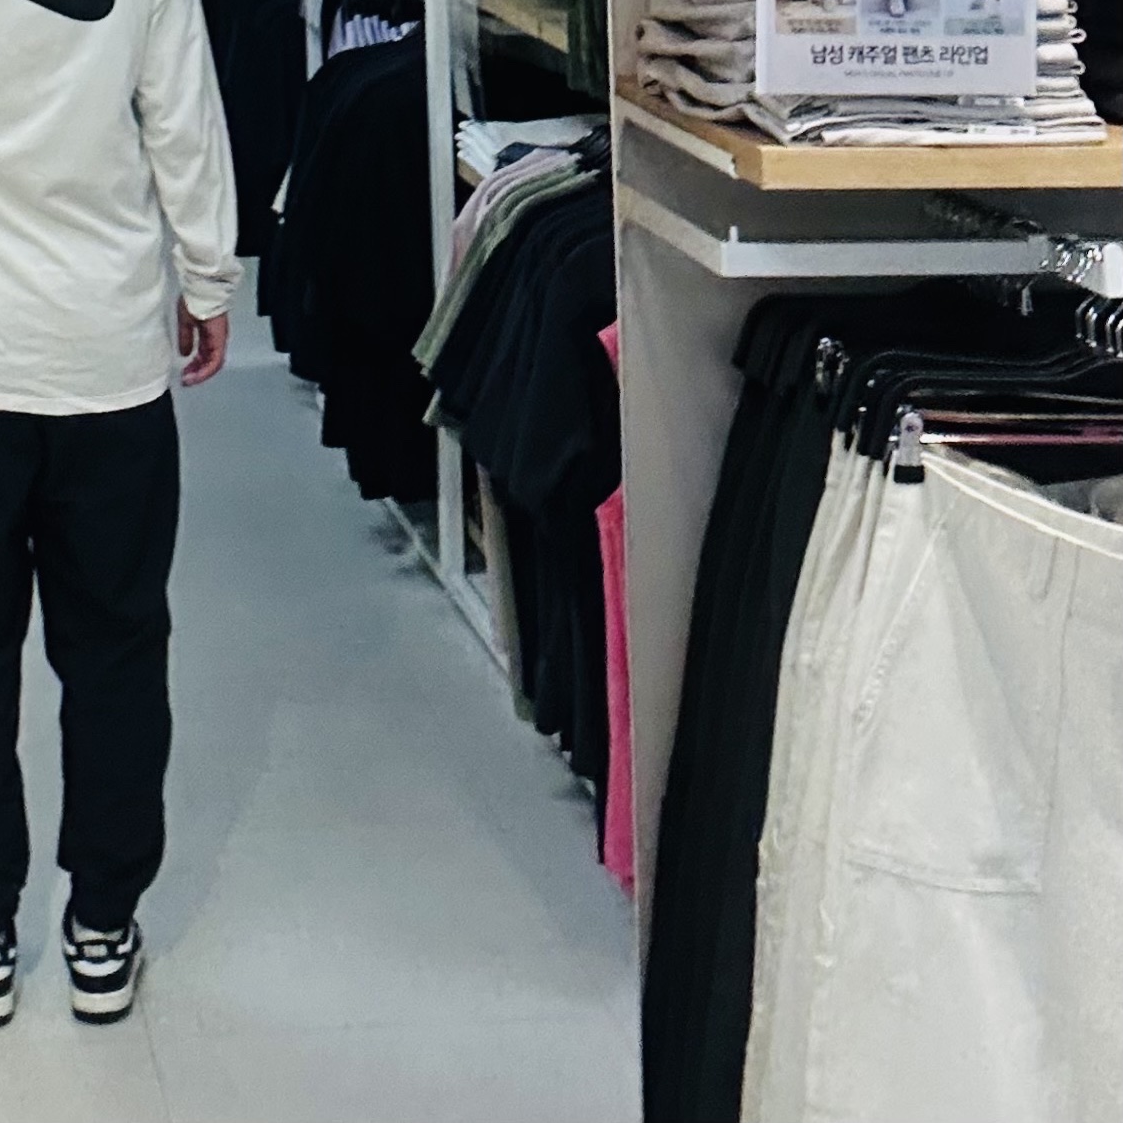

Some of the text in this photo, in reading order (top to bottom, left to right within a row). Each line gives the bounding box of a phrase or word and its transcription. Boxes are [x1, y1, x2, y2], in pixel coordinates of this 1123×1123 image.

[811, 44, 988, 65] 남성 캐주얼 팬츠 라인업
